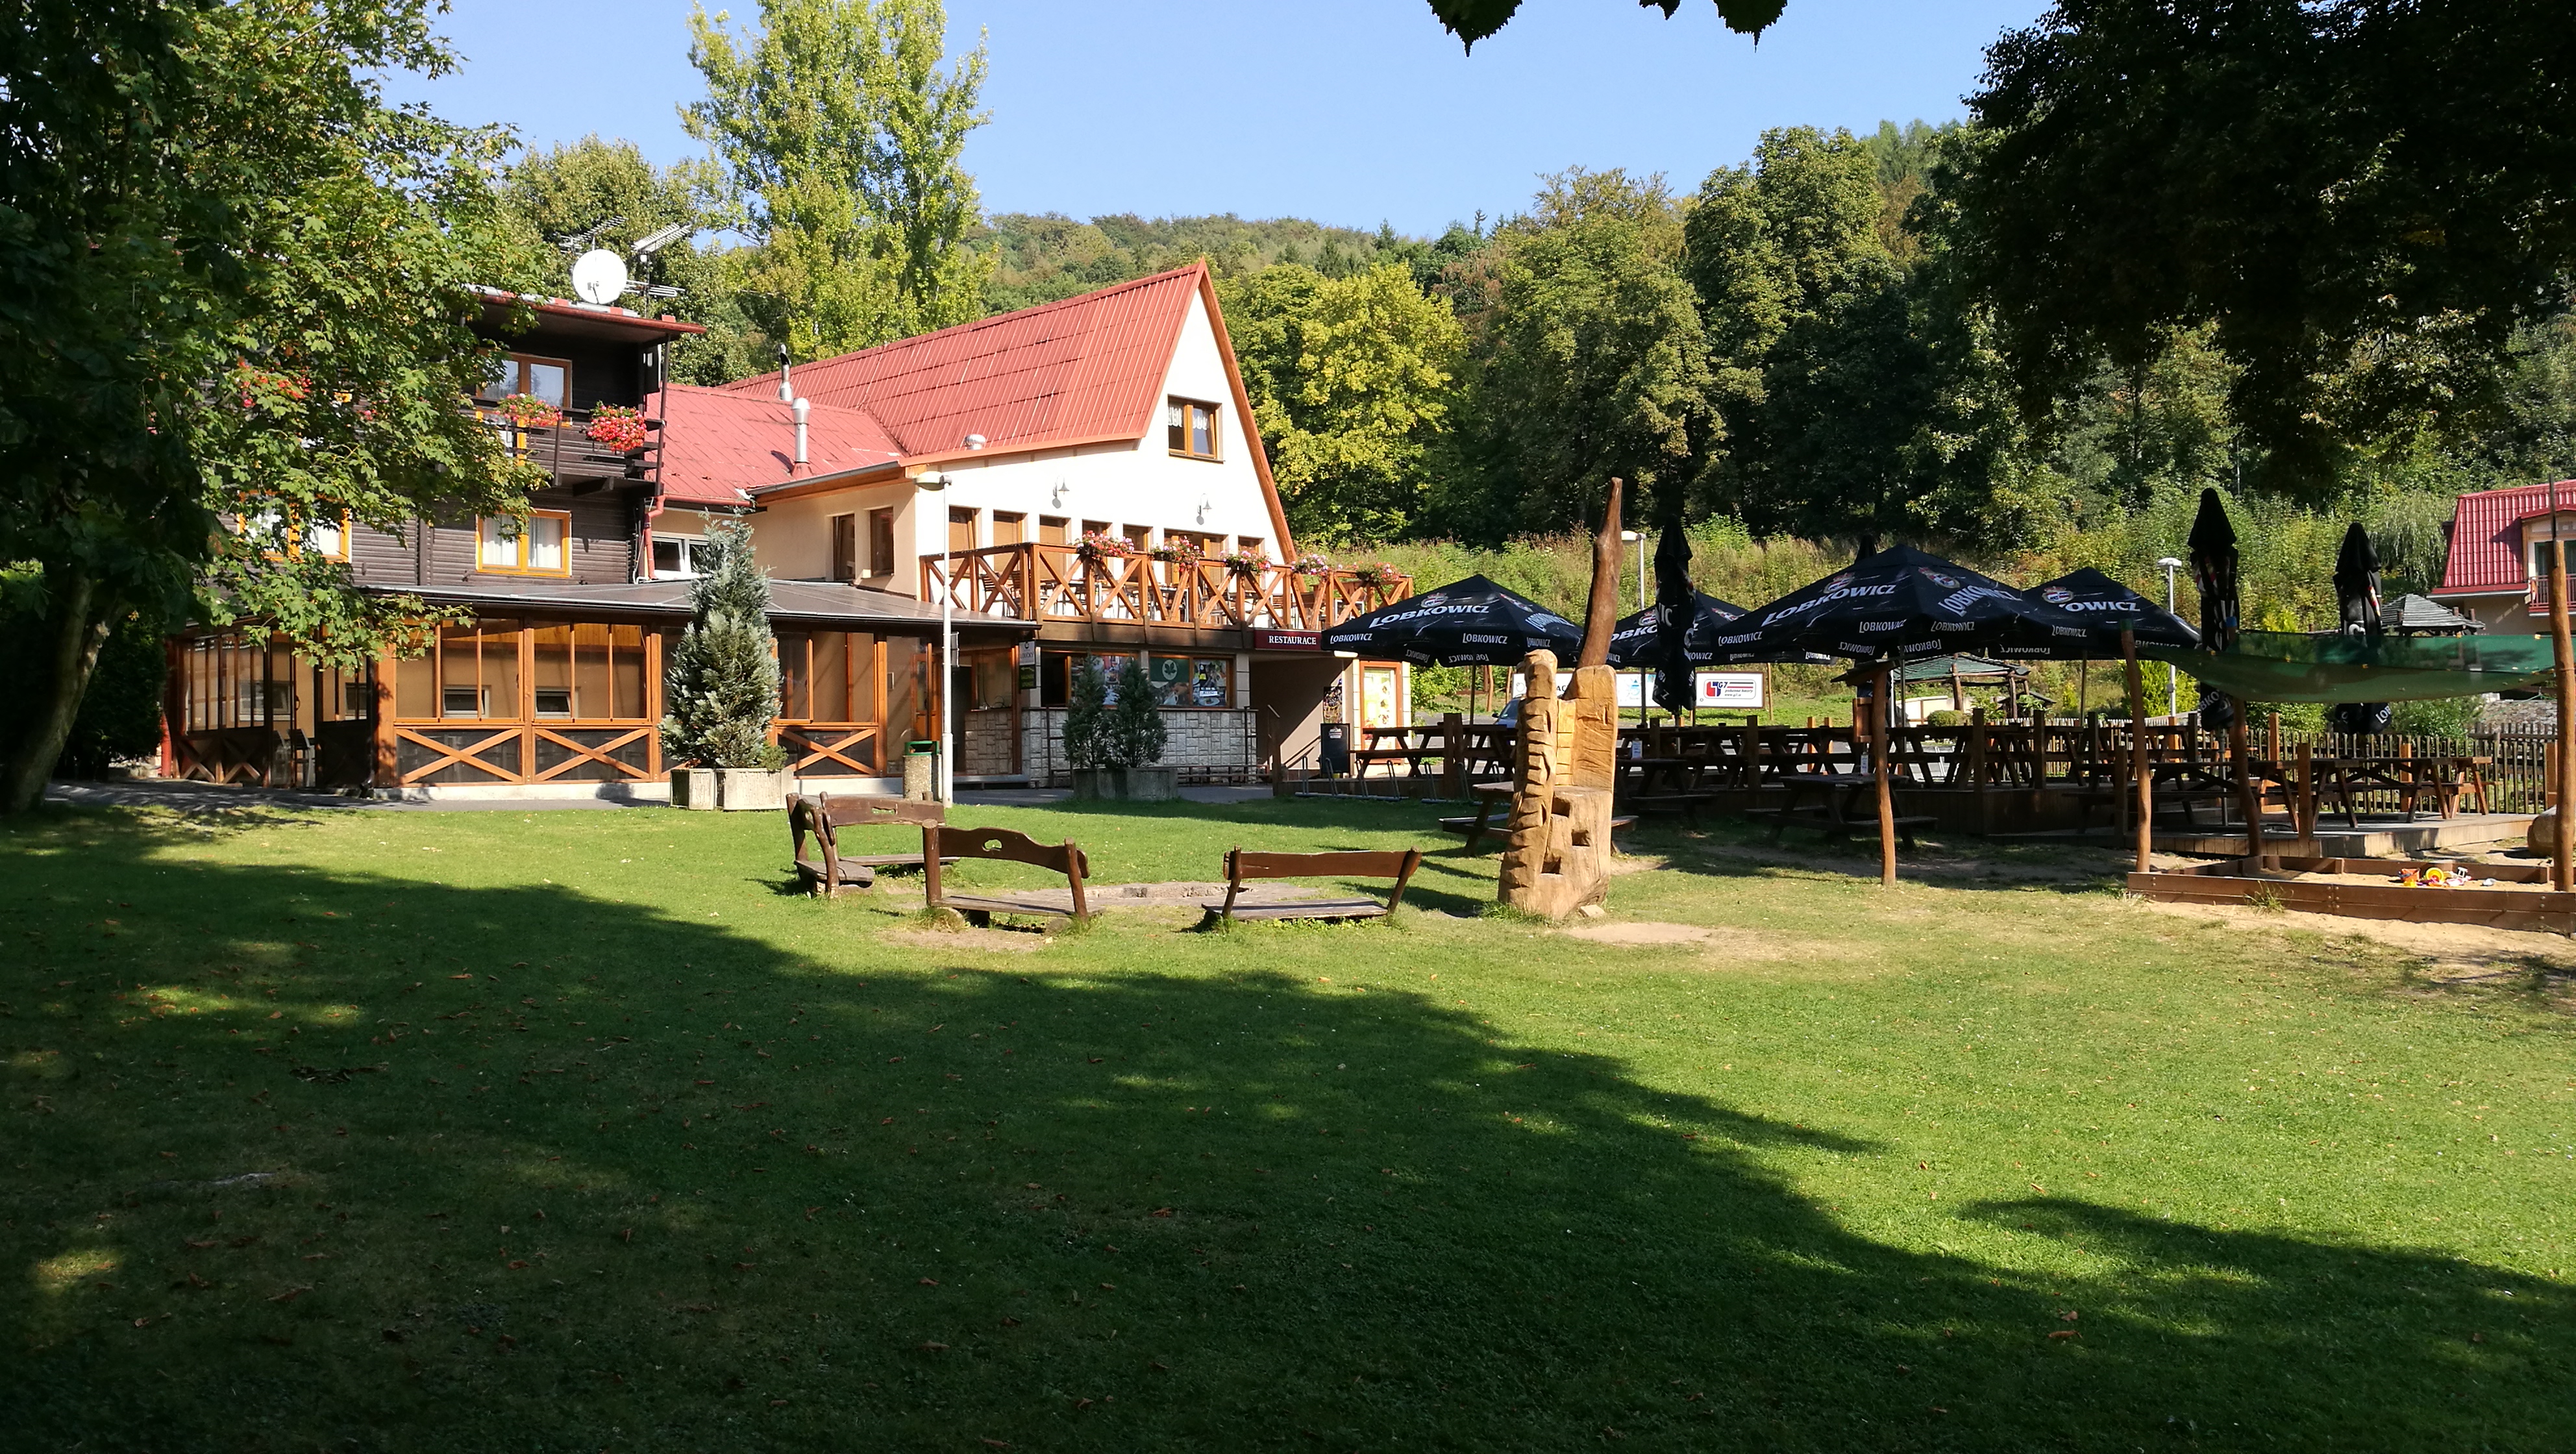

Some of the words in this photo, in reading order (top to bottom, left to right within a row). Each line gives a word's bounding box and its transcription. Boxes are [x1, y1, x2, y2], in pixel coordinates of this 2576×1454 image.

[1761, 584, 1896, 627] LOBKOWICZ
[1938, 585, 2023, 617] LOBKOWICZ
[2059, 601, 2141, 612] OWICZ
[1368, 604, 1490, 628] LOBKOWICZ
[1859, 619, 1907, 634] LOBKOWICZ
[1930, 621, 1975, 632] LOBKOWICZ
[1269, 635, 1317, 645] RESTAURACE
[1330, 633, 1373, 645] LOBKOWICZ
[1462, 633, 1509, 645] LOBKOWICZ
[1718, 631, 1763, 646] LOBKOWICZ
